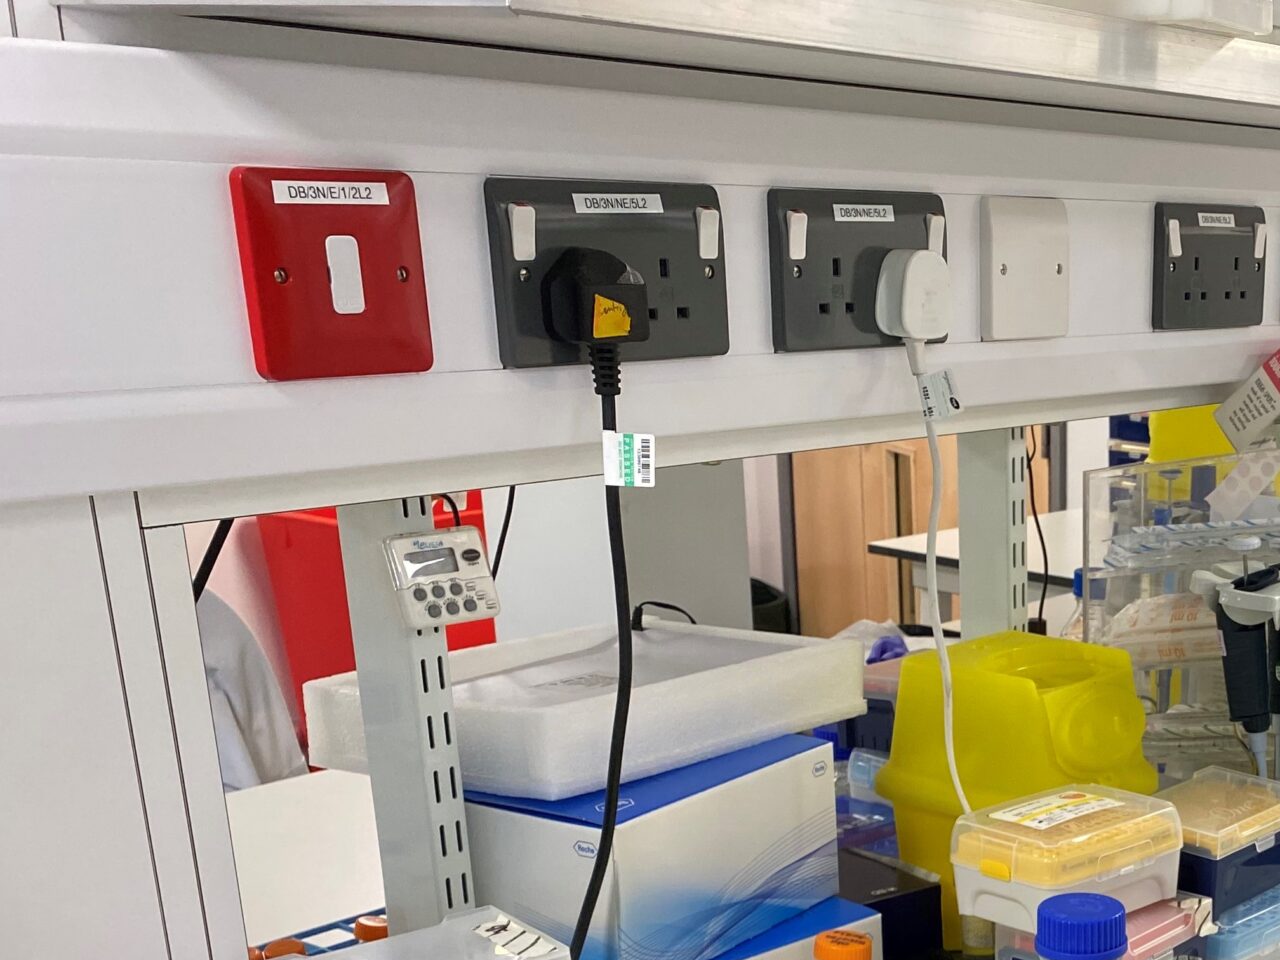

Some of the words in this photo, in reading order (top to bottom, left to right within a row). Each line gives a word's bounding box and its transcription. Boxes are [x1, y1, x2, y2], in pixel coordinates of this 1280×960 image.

[288, 186, 372, 199] DB/3N/E/1/2L2
[584, 198, 648, 209] DB/3N/NE/5L2
[840, 208, 887, 217] DB/3N/NE/5L2
